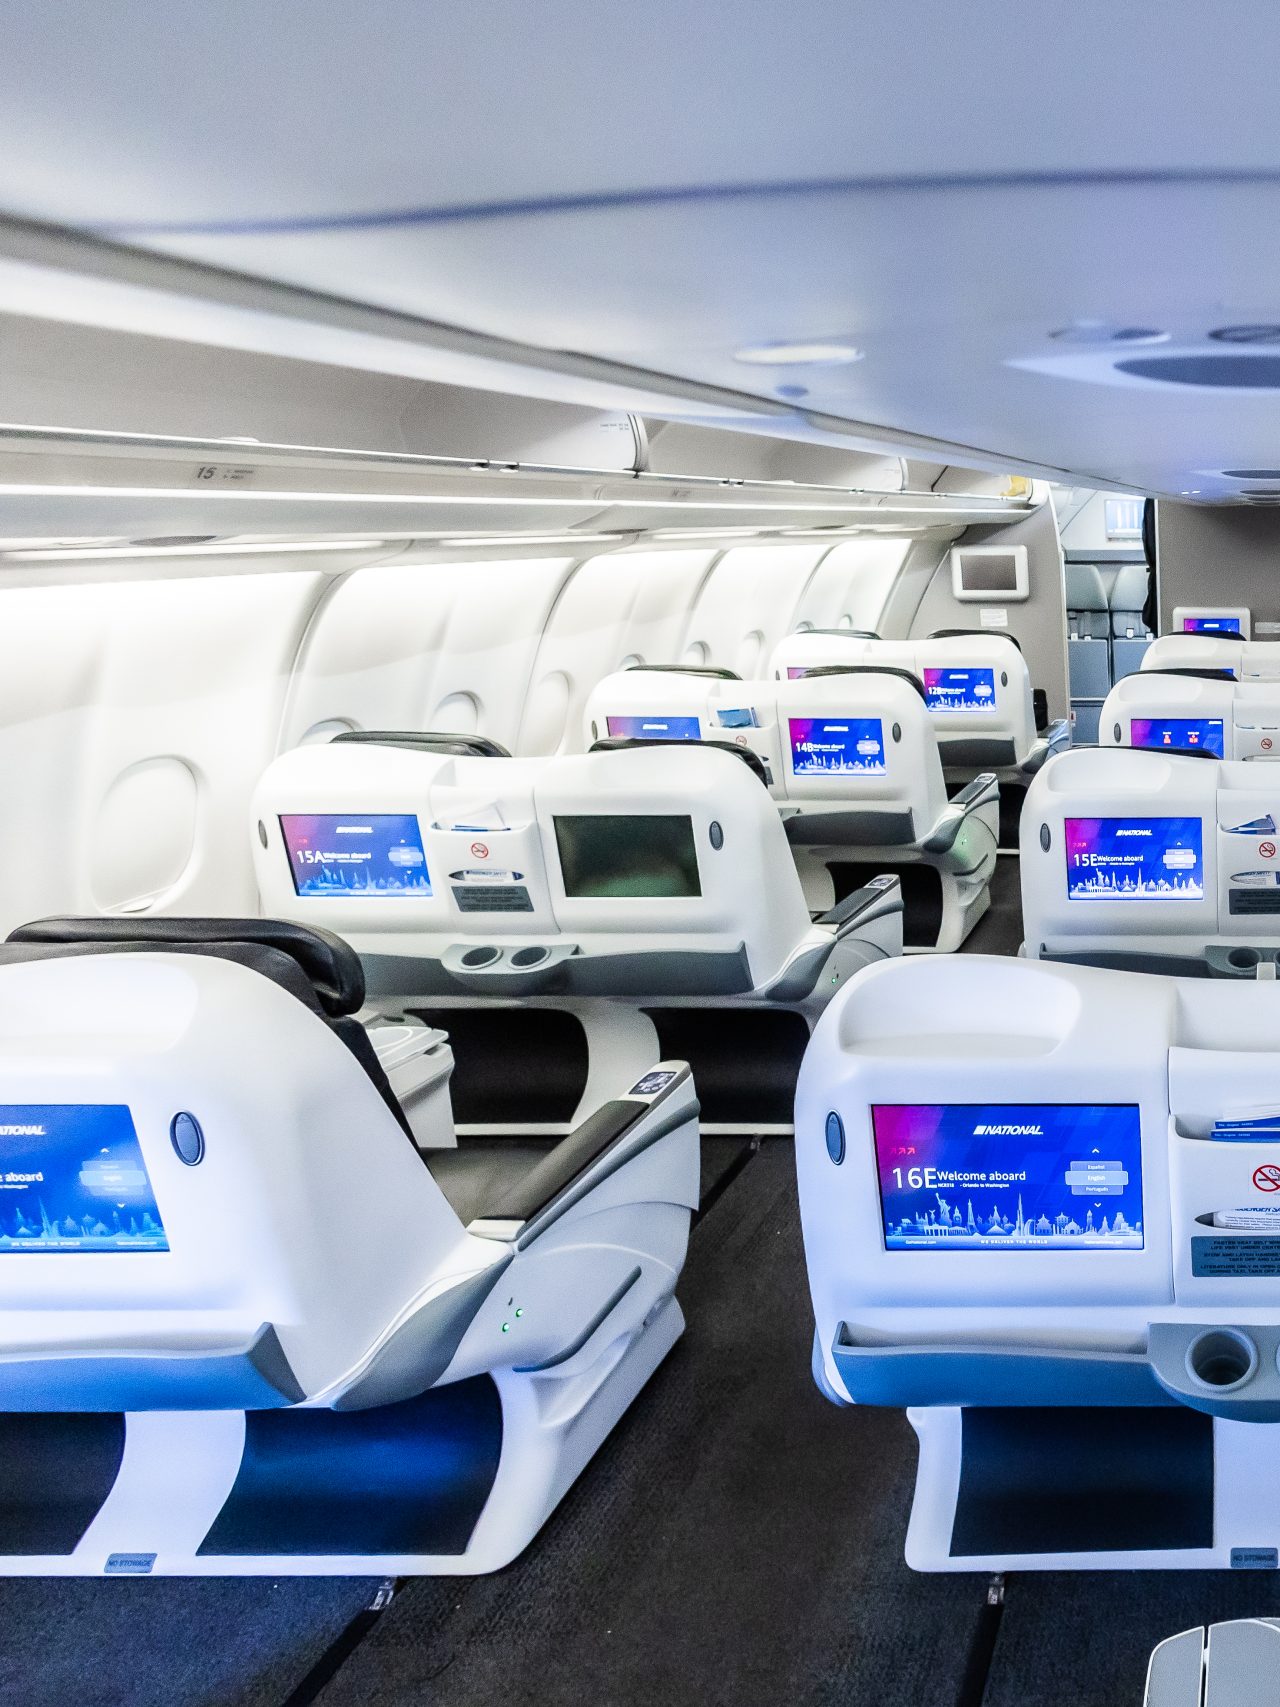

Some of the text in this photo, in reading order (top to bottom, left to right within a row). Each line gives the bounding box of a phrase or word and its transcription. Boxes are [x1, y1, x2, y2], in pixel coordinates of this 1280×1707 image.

[197, 466, 217, 479] 15
[297, 850, 325, 863] 15A
[1074, 854, 1098, 866] 15E
[984, 1125, 1044, 1135] NATIONAL
[6, 1172, 43, 1181] aboard
[892, 1167, 937, 1188] 16E
[937, 1171, 1026, 1181] Welcome aboard
